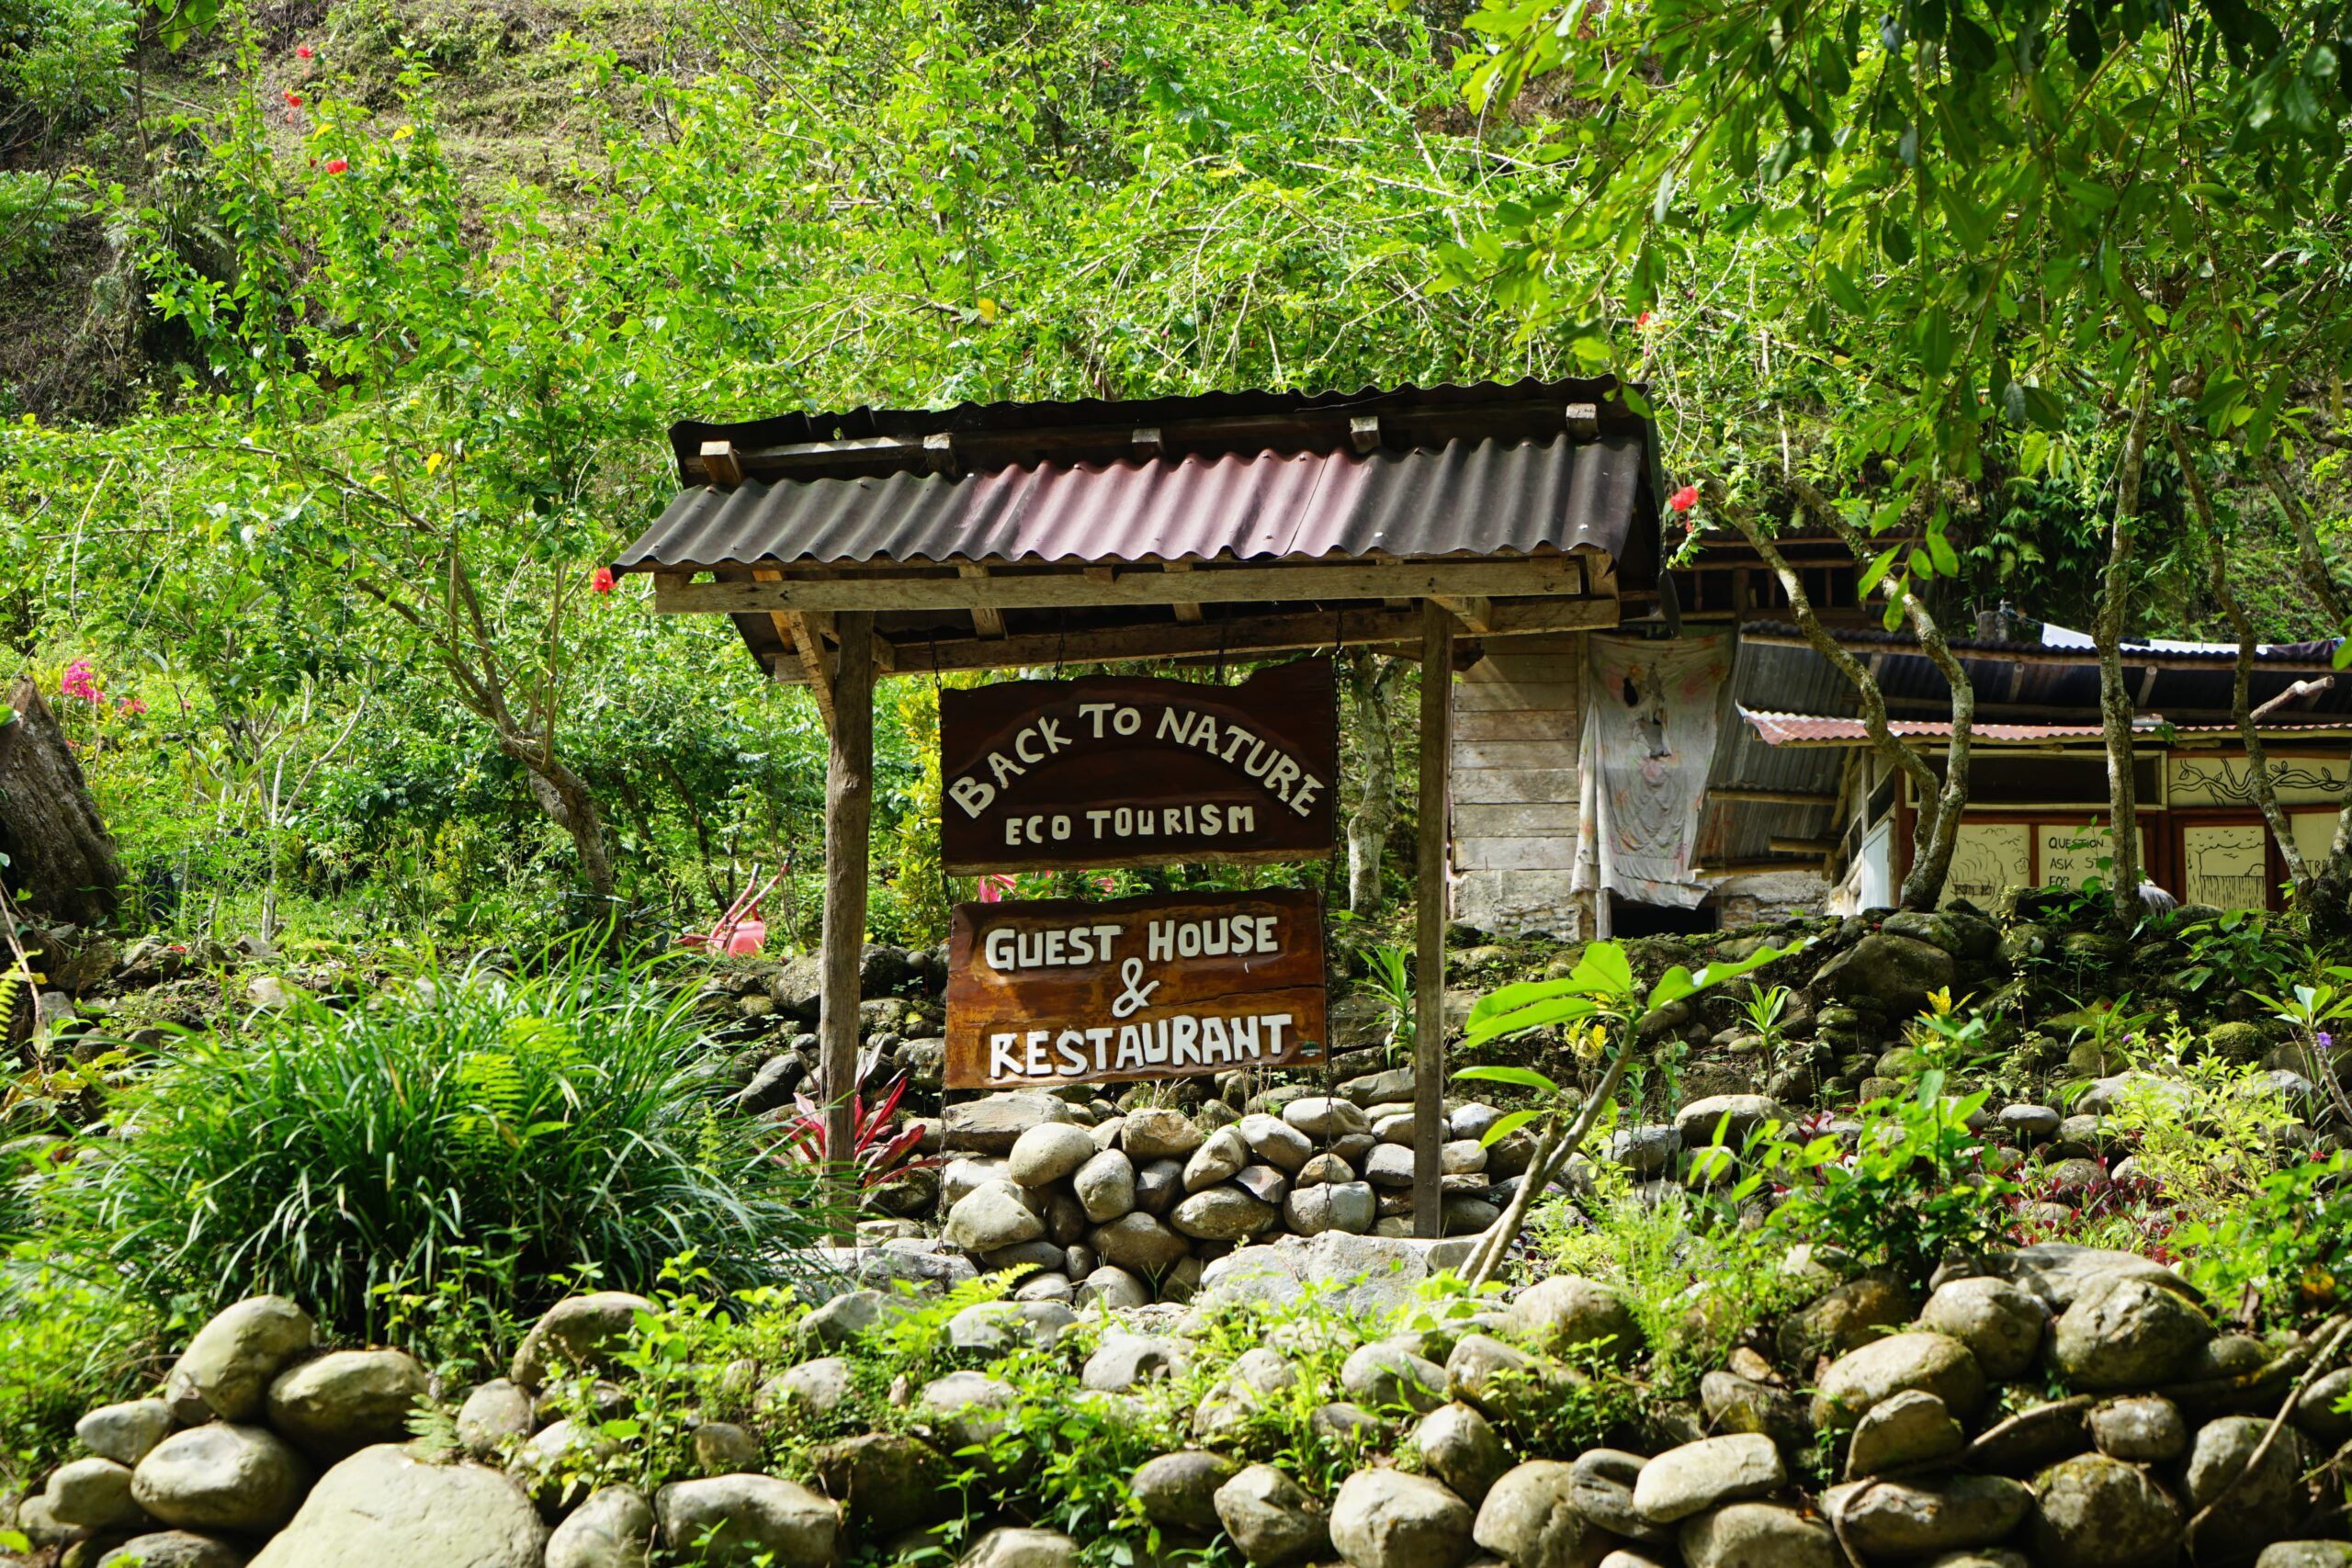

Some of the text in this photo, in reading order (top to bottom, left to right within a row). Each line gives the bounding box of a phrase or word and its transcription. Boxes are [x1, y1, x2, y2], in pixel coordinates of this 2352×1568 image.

[948, 702, 1325, 818] BACK TO NATURE
[1005, 804, 1255, 845] ECO TOURISM
[985, 915, 1278, 971] GUEST HOUSE
[1112, 957, 1160, 1018] &
[989, 1013, 1292, 1079] RESTAURANT
